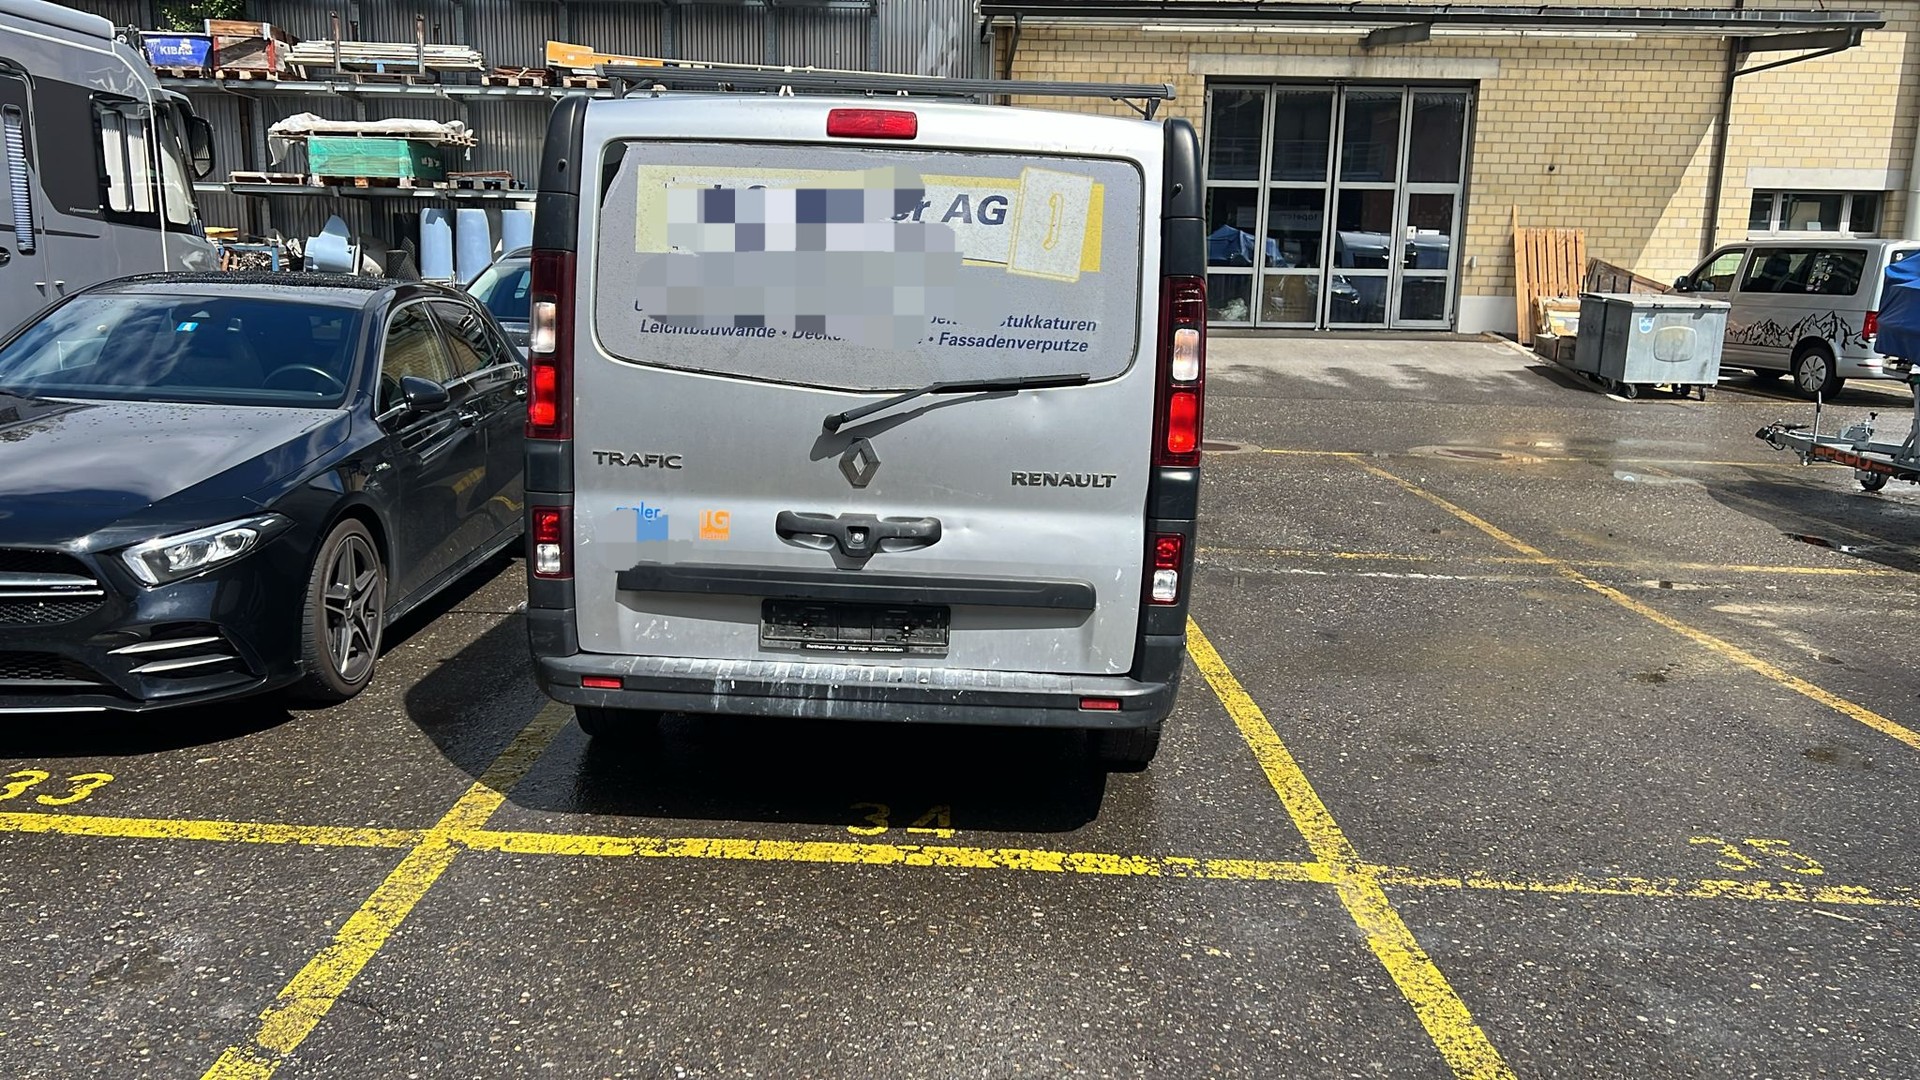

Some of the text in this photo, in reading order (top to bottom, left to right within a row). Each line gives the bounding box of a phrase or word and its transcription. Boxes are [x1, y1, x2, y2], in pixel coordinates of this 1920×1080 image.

[940, 194, 1009, 226] AG
[1000, 314, 1097, 332] tukkaturen
[938, 331, 1089, 354] Fassadenverputze
[592, 451, 683, 470] TRAFIC
[1011, 471, 1117, 488] RENAULT
[0, 769, 115, 806] 33
[846, 802, 956, 839] 34
[1688, 836, 1825, 876] 35
